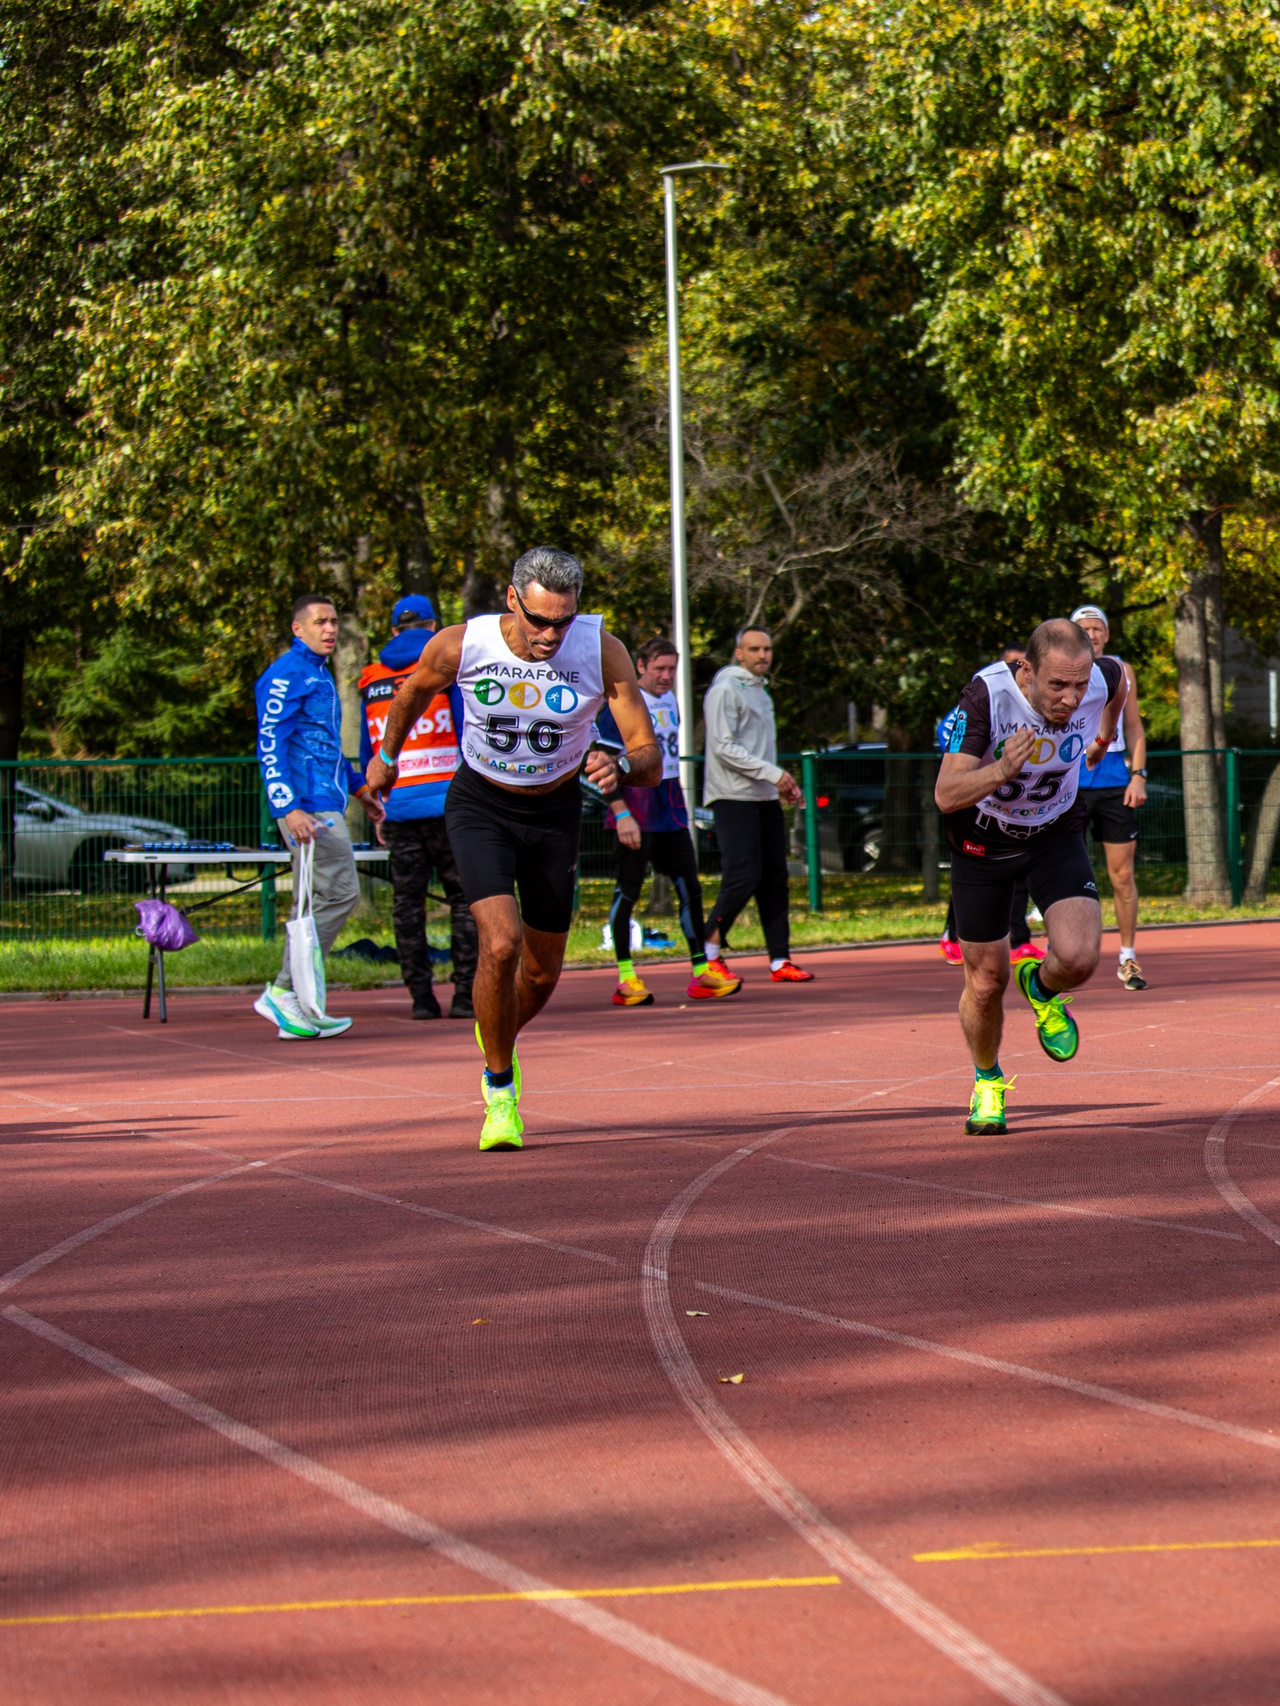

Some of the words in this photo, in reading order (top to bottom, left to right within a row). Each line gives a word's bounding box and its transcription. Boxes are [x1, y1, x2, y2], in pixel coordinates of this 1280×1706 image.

[475, 665, 580, 683] VMARAFONE
[367, 684, 391, 699] Arta
[259, 678, 291, 780] РОСАТОМ
[485, 713, 564, 757] 56
